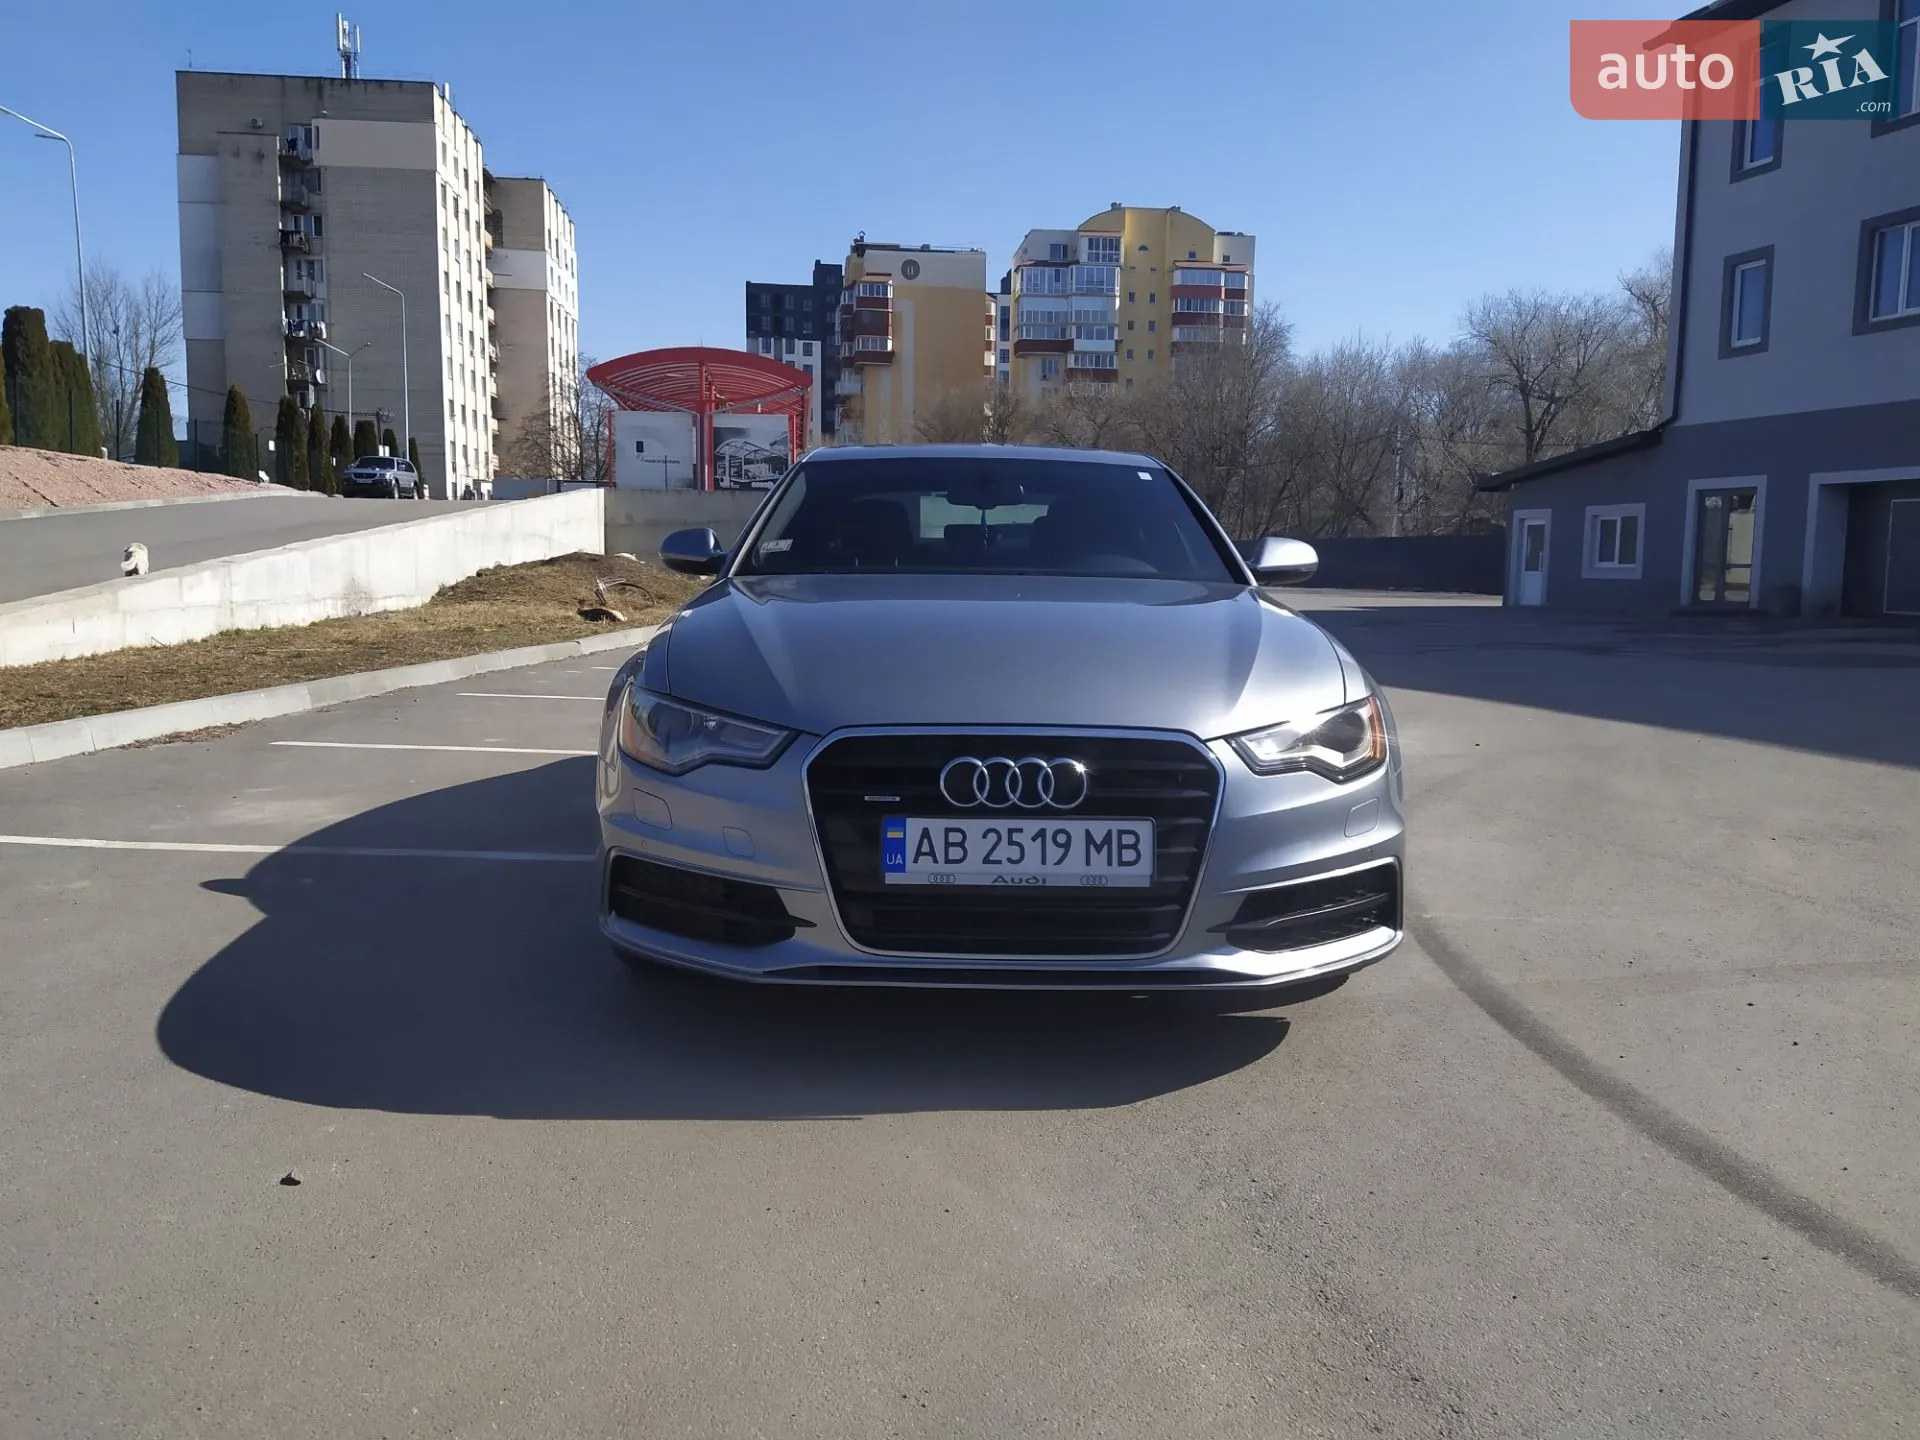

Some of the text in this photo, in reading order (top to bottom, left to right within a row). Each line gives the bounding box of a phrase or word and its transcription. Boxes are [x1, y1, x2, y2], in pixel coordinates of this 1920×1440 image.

[912, 826, 1142, 867] AB 2519 MB
[886, 853, 904, 865] UA
[991, 875, 1047, 885] Audi
